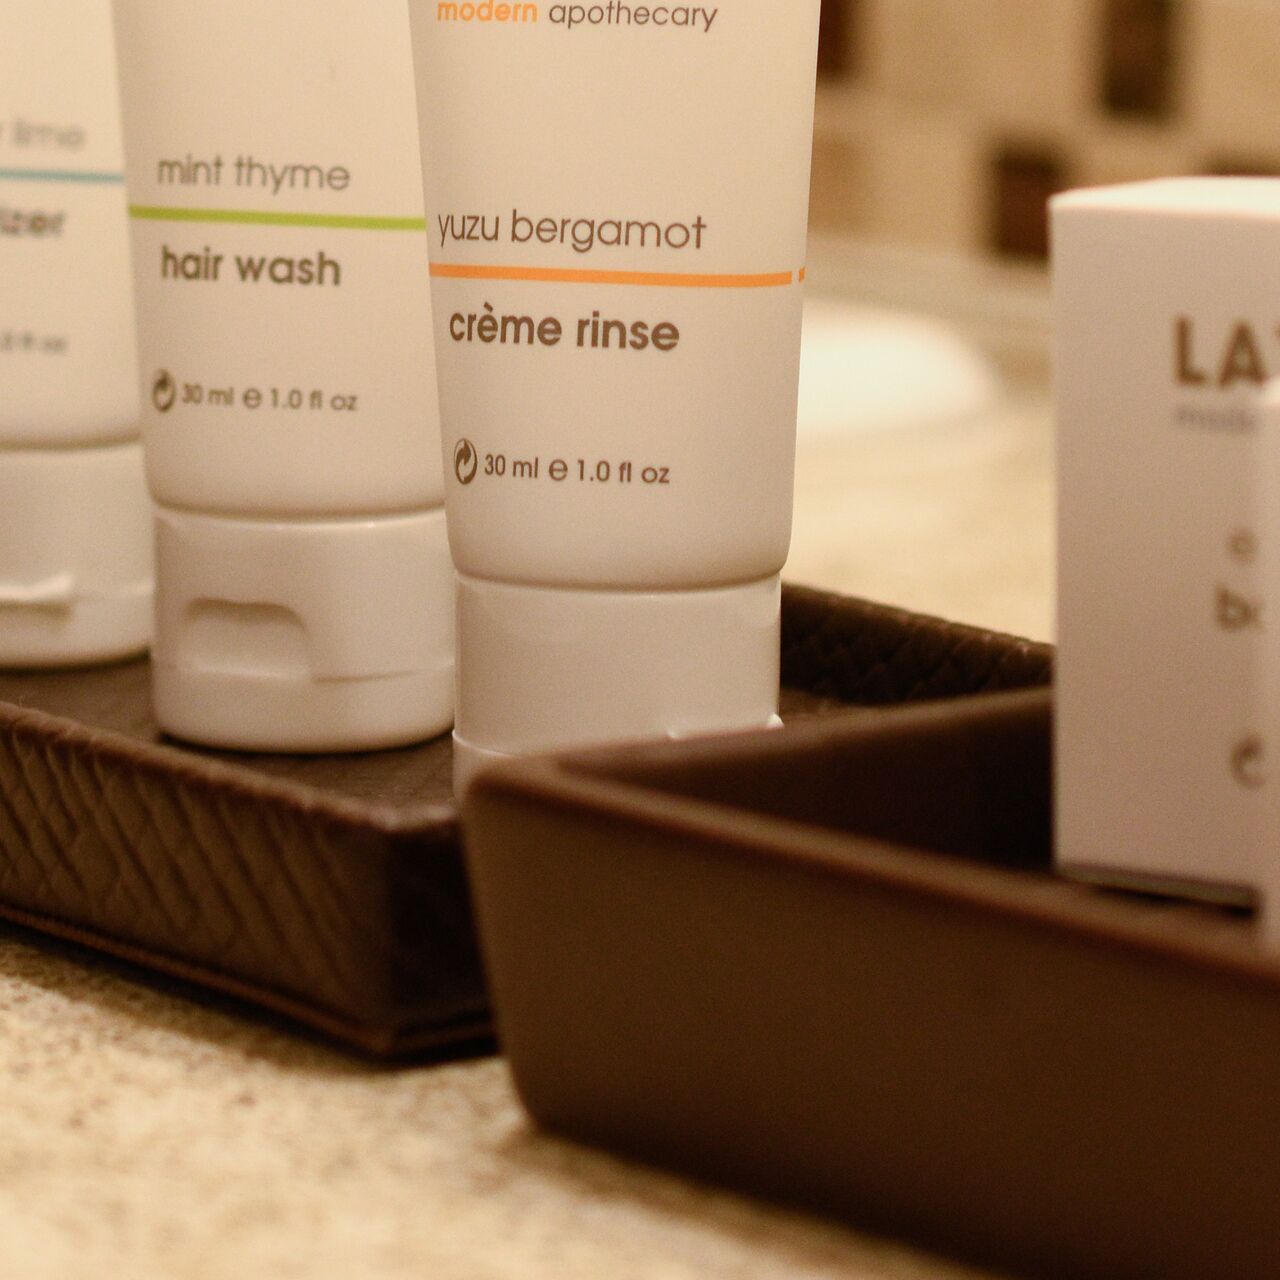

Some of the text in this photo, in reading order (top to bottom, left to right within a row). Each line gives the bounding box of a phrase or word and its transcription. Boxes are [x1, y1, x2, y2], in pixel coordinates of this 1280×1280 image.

[548, 0, 718, 33] apothecary
[157, 154, 351, 195] mint thyme
[438, 208, 707, 254] yuzu bergamot
[161, 245, 341, 286] hair wash
[450, 302, 680, 352] crème rinse
[182, 382, 203, 405] 30
[208, 387, 234, 406] ml
[270, 387, 304, 410] 1.0
[309, 390, 323, 409] fl
[330, 394, 358, 412] oz
[484, 453, 507, 477] 30
[512, 457, 539, 479] ml
[577, 459, 610, 483] 1.0
[619, 462, 632, 483] fl
[641, 466, 670, 485] oz
